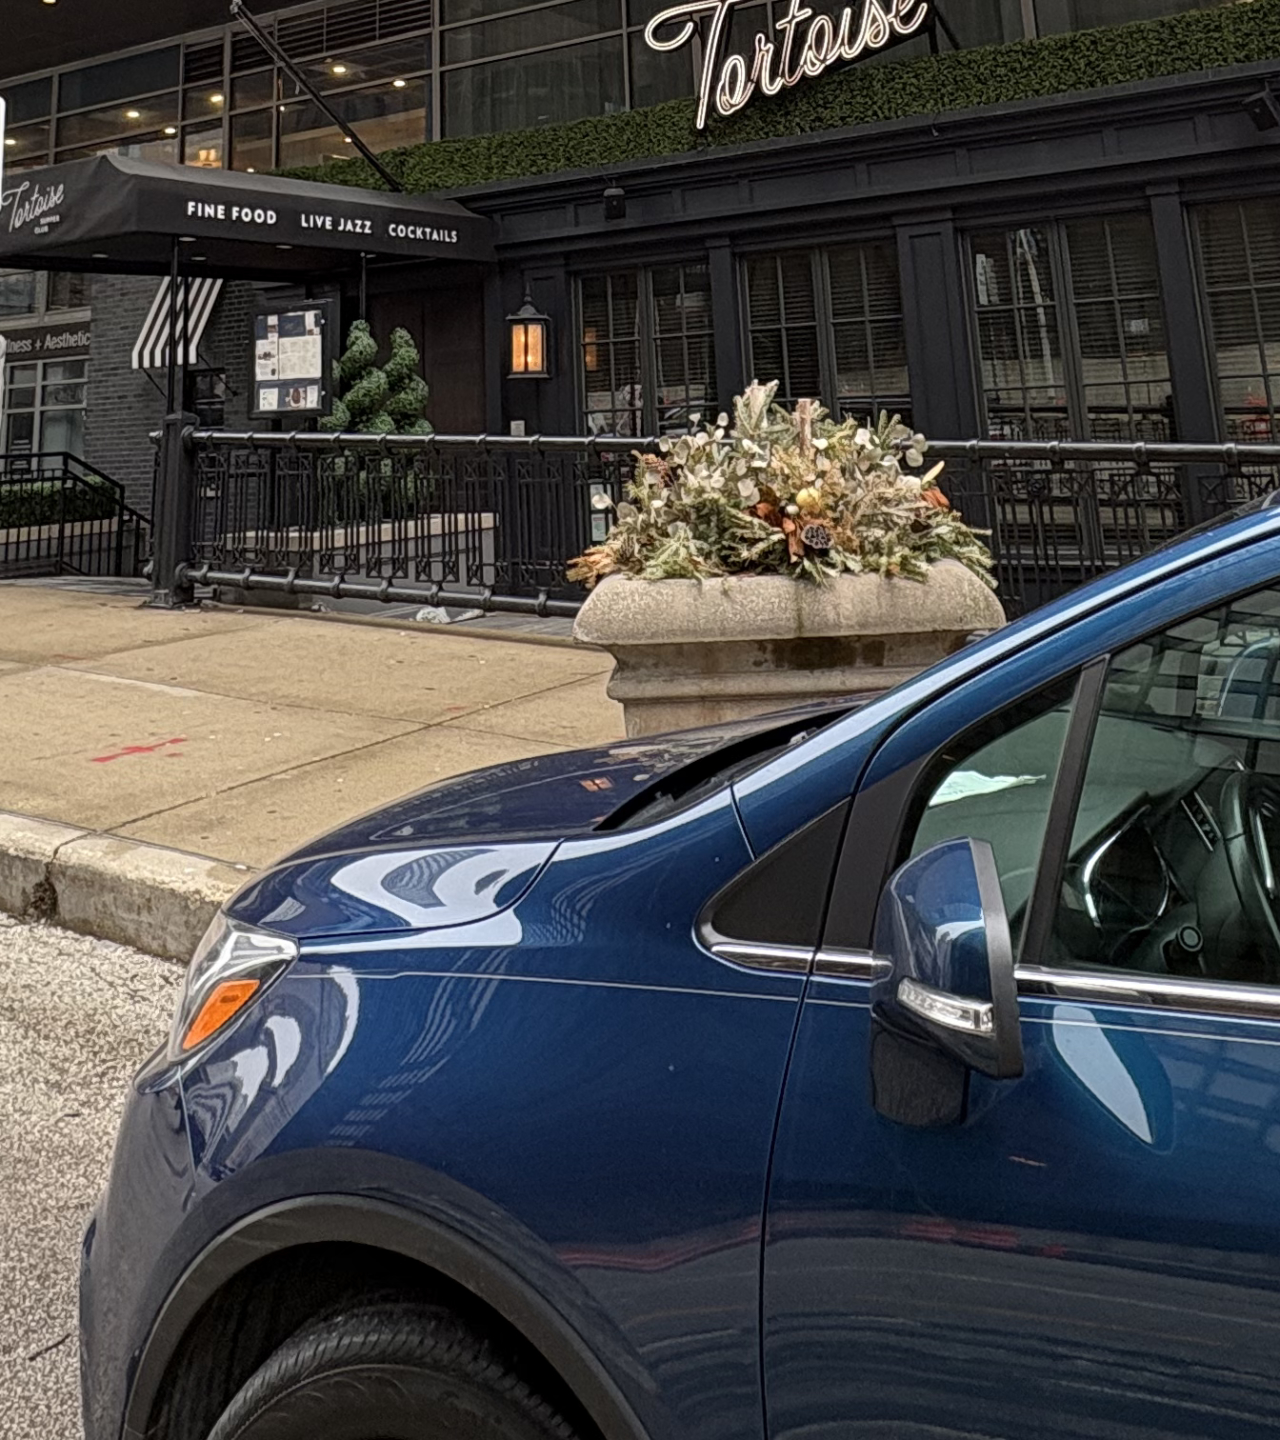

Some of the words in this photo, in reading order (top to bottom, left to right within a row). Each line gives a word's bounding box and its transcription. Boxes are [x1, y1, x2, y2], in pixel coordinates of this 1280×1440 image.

[1, 180, 64, 233] Tortoise
[187, 201, 226, 221] FINE
[231, 206, 277, 226] FOOD
[301, 213, 333, 230] LIVE
[337, 216, 373, 235] JAZZ
[388, 222, 458, 244] COCKTAILS
